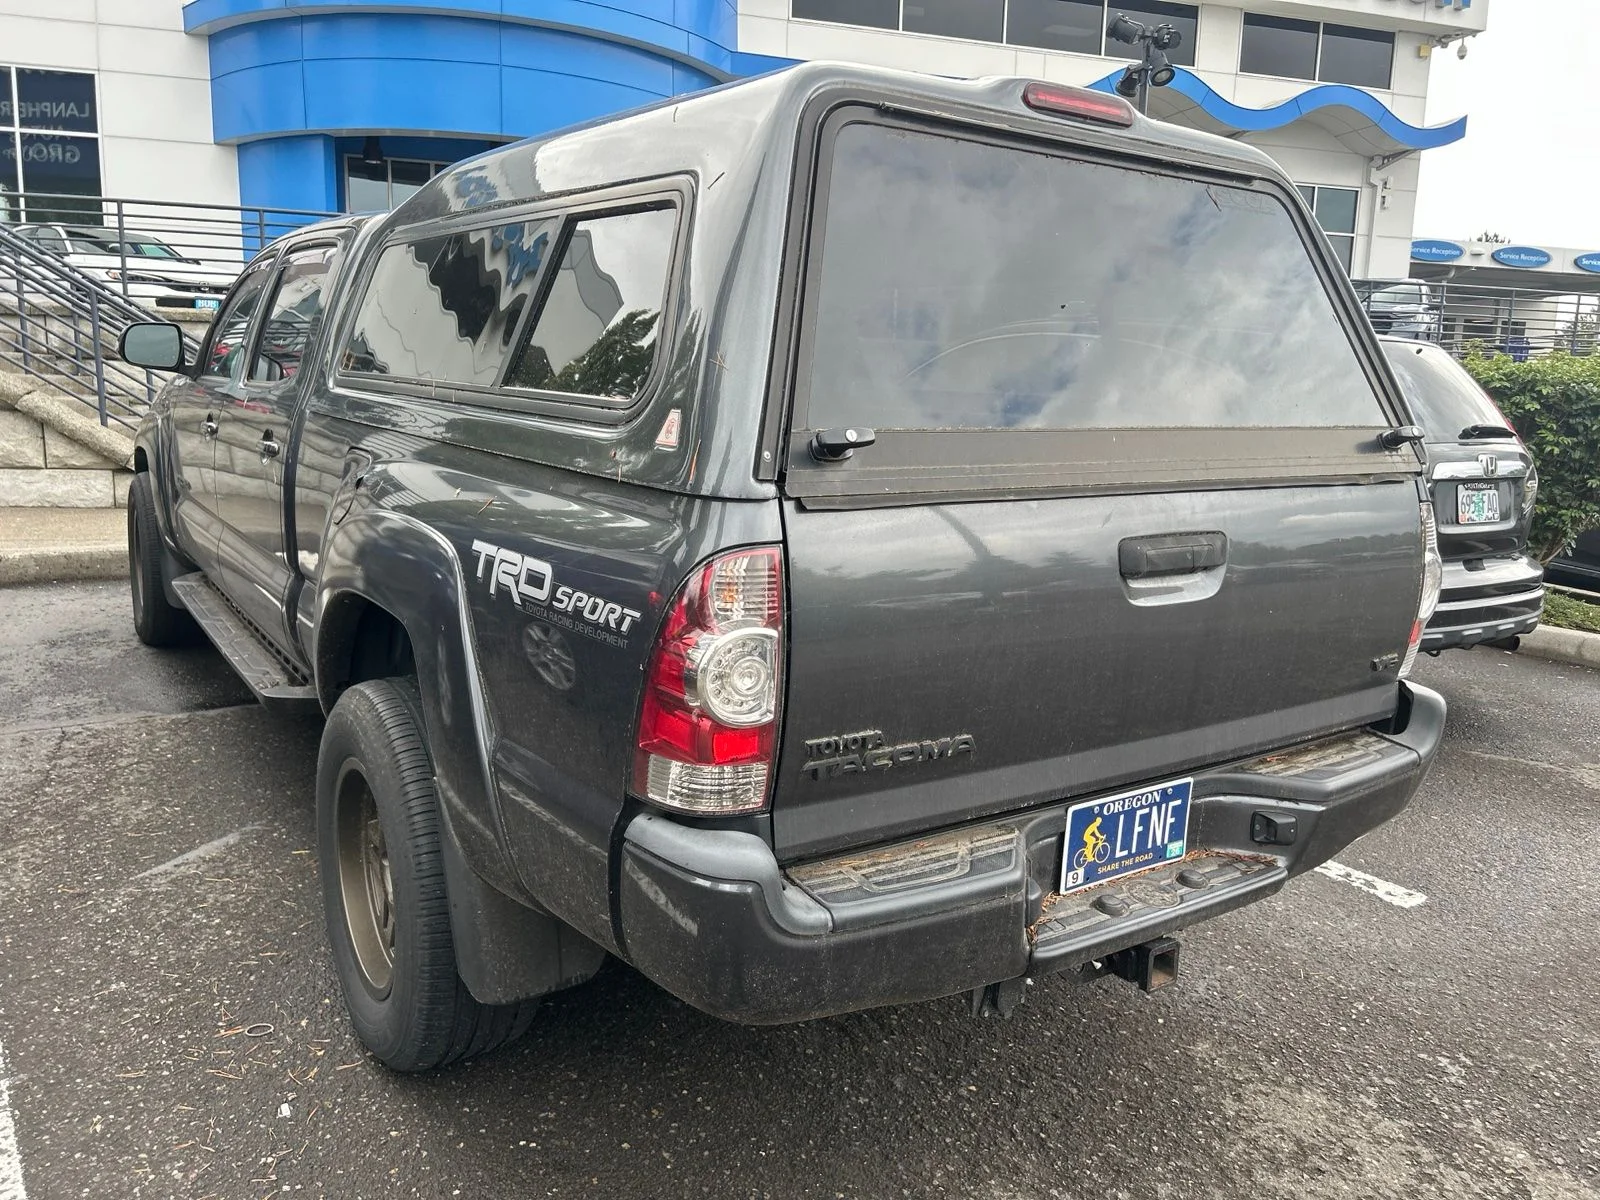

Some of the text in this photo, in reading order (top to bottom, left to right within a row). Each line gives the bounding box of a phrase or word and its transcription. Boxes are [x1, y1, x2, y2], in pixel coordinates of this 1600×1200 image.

[1432, 247, 1460, 256] Reception
[1500, 252, 1548, 262] Service Reception
[472, 538, 643, 635] TRD SPORT
[525, 601, 629, 650] TOYOTA RACING DEVELOPMENT
[805, 729, 884, 757] TOYOTA
[800, 734, 977, 781] TACOMA
[1103, 790, 1163, 816] OREGON
[1115, 799, 1182, 858] LFNF
[1097, 852, 1154, 875] SHARE THE ROAD
[1071, 872, 1080, 884] 9
